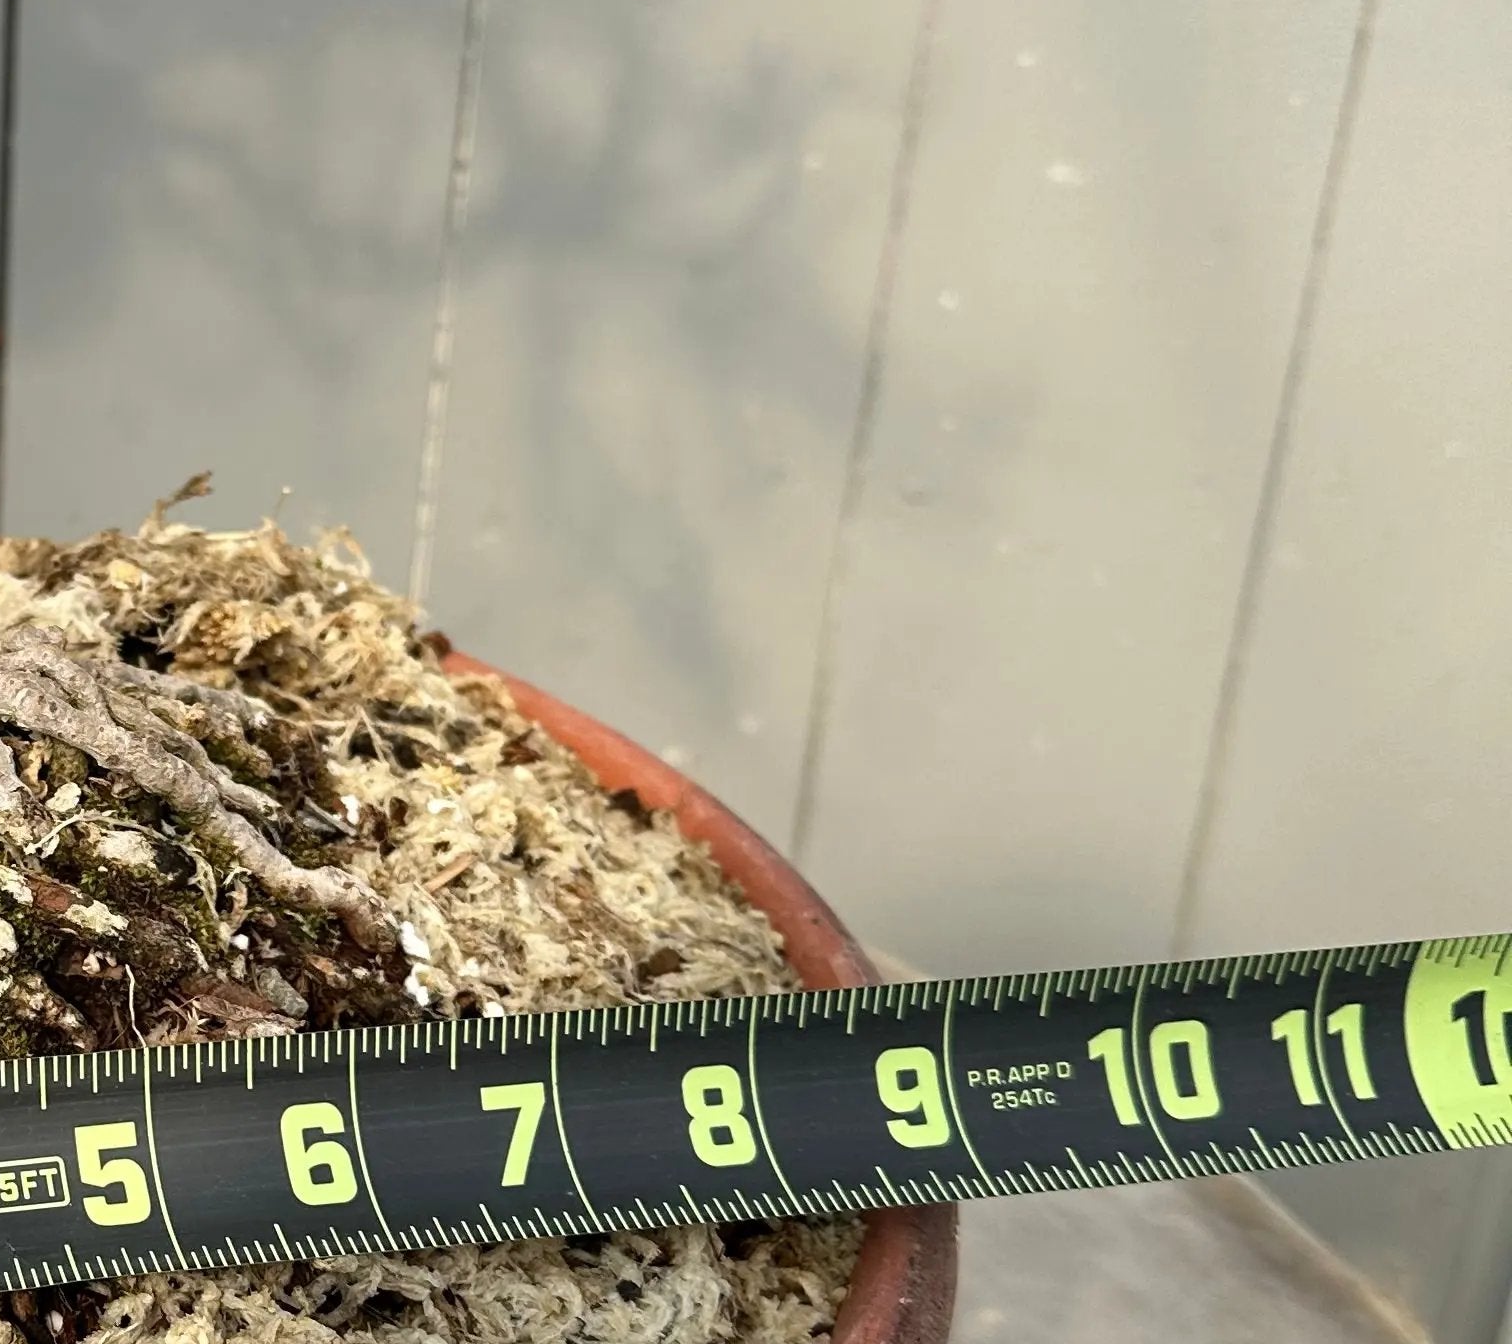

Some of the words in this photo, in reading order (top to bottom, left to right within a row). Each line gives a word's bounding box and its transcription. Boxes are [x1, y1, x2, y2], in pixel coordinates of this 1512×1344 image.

[1088, 1019, 1222, 1126] 10
[1271, 1003, 1378, 1106] 11
[1451, 989, 1512, 1086] 1
[480, 1082, 545, 1187] 7
[681, 1065, 757, 1167] 8
[874, 1046, 951, 1148] 9
[73, 1121, 151, 1227] 5
[280, 1102, 359, 1206] 6
